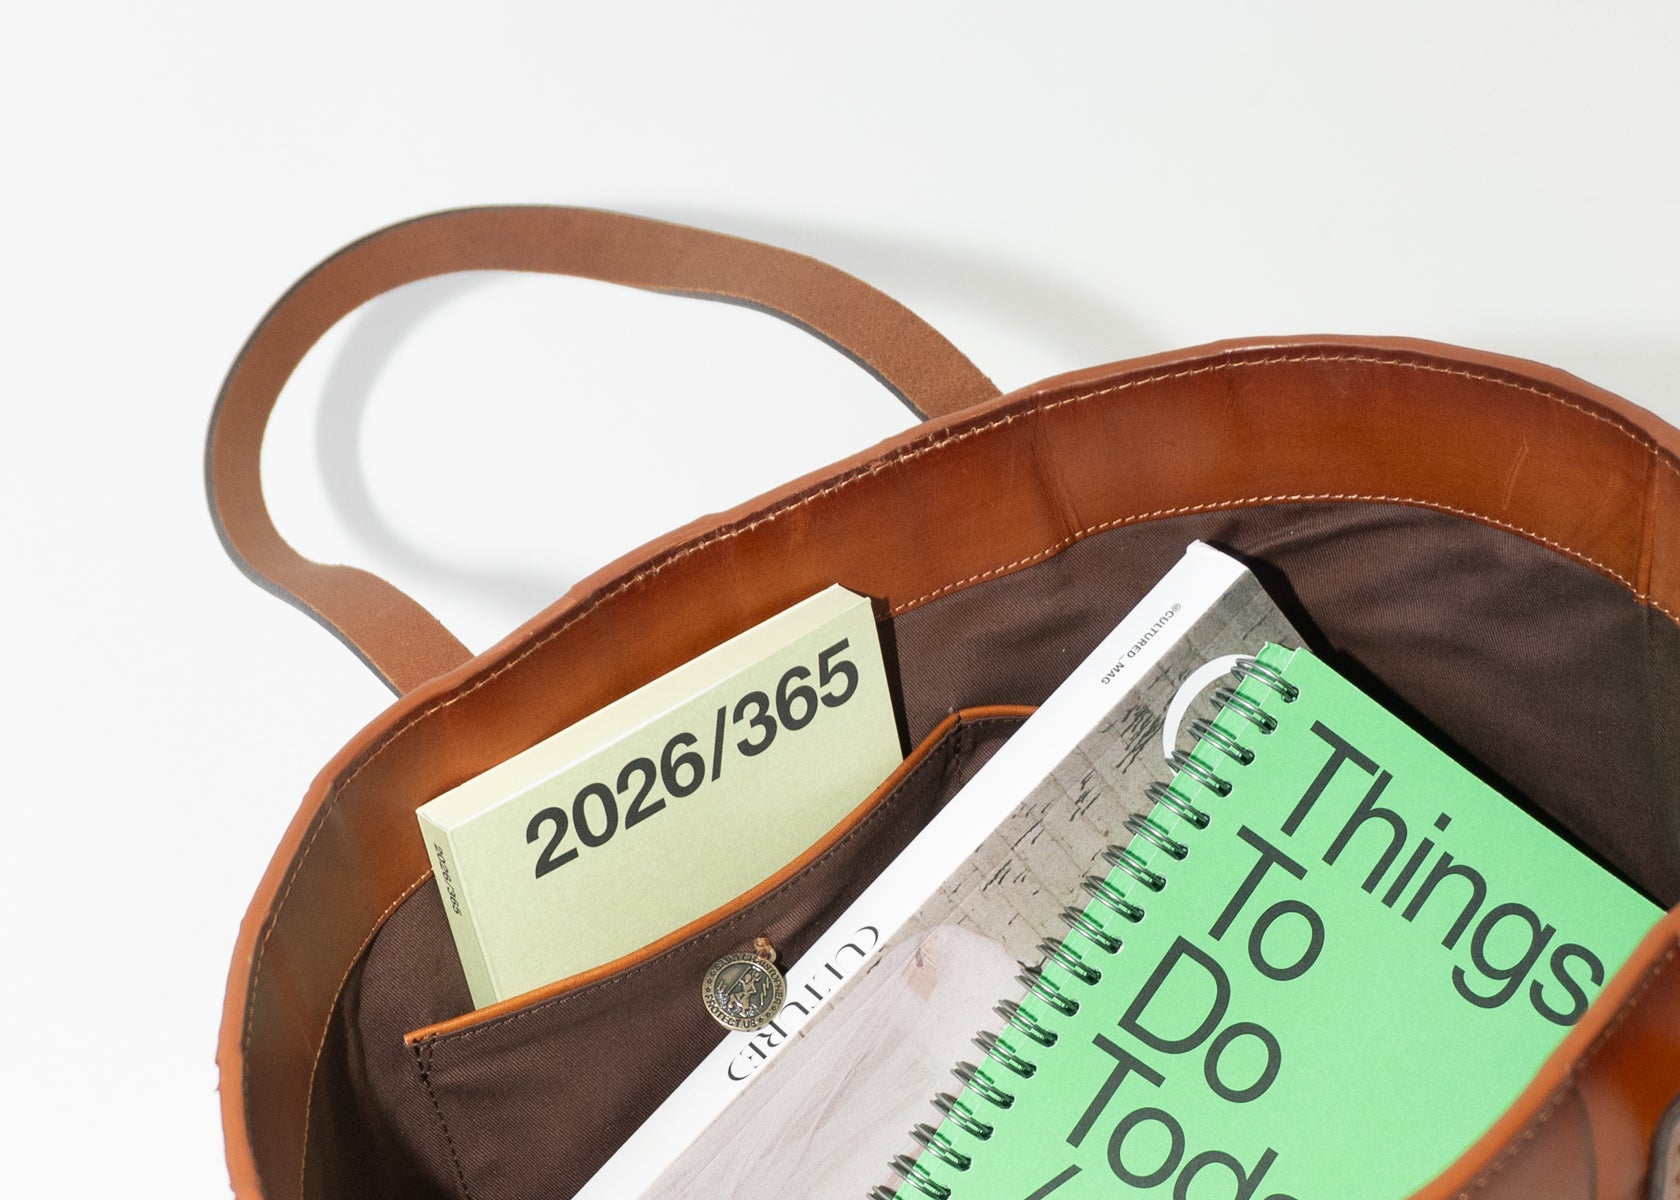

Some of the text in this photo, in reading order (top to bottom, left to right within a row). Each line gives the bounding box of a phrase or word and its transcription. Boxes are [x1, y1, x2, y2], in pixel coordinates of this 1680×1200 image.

[1101, 603, 1182, 685] @CULTURED_MAG
[525, 637, 859, 880] 2026/365
[433, 842, 462, 917] 2026/365
[1208, 825, 1325, 981] To
[1280, 720, 1605, 1027] Things
[705, 994, 757, 1029] PROTECT US
[728, 926, 879, 1081] CULTURED
[1117, 935, 1282, 1103] Do
